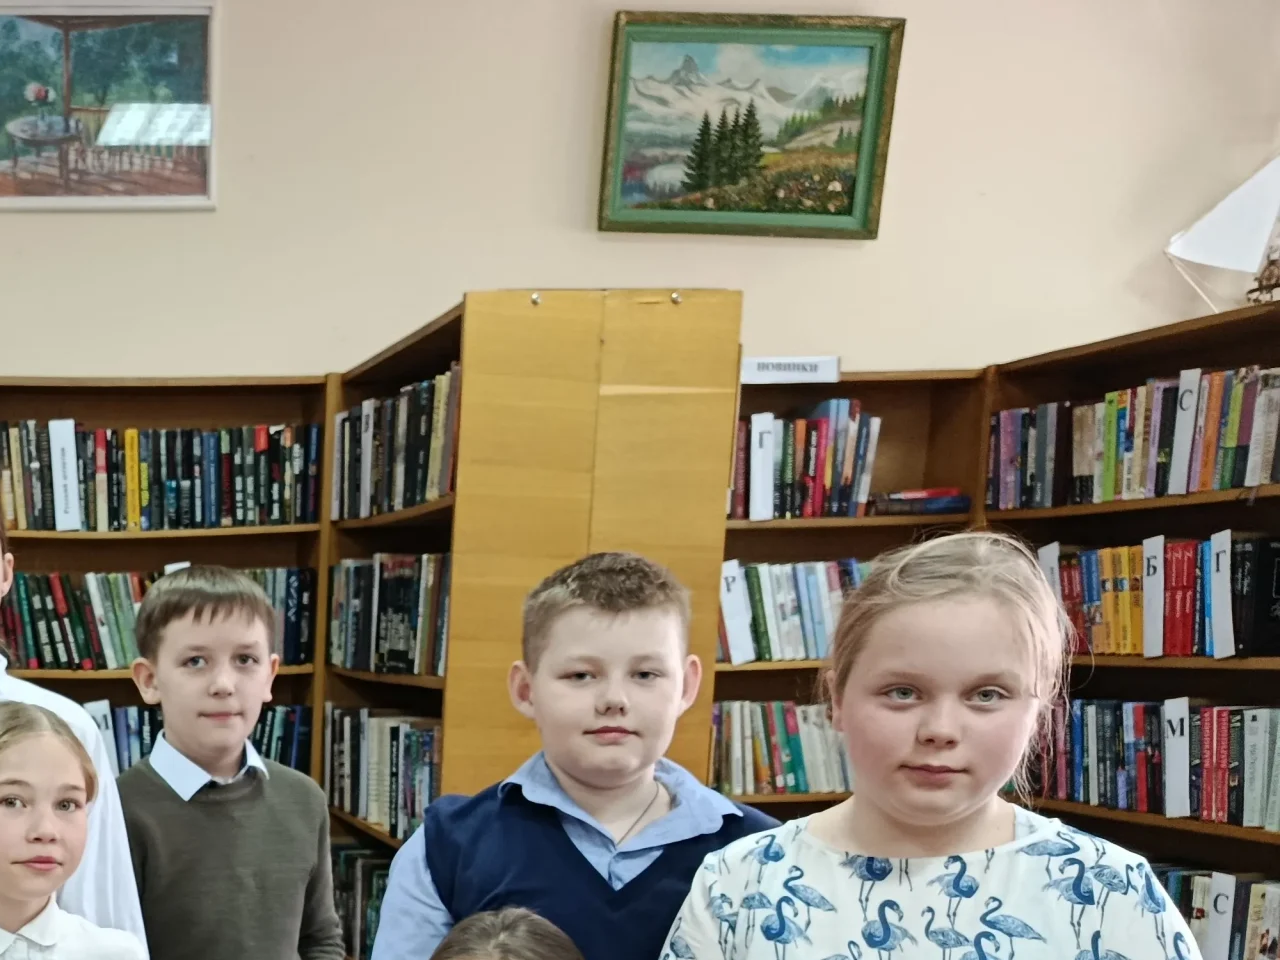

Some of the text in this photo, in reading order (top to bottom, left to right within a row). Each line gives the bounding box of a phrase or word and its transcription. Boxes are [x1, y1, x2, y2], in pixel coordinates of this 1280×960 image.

[759, 431, 772, 449] Г
[1146, 555, 1157, 577] Б
[1215, 550, 1226, 573] Г
[724, 576, 736, 592] Р
[1166, 718, 1185, 739] М
[1213, 893, 1229, 915] С
